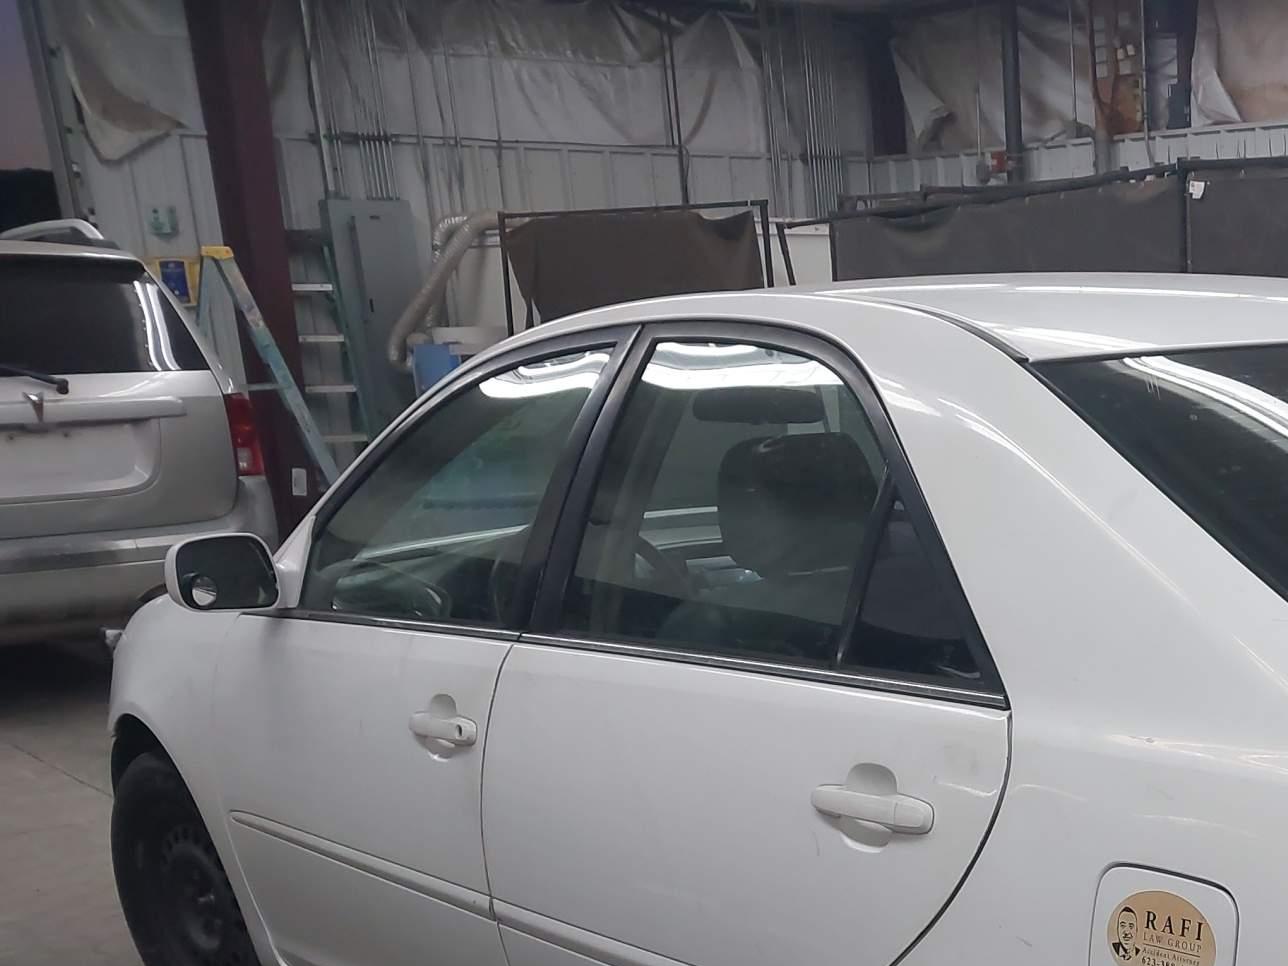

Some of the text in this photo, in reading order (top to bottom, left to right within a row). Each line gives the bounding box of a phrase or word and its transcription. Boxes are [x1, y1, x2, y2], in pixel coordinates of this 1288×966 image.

[1144, 910, 1204, 941] RAFI
[1143, 931, 1202, 953] LAW GROUP
